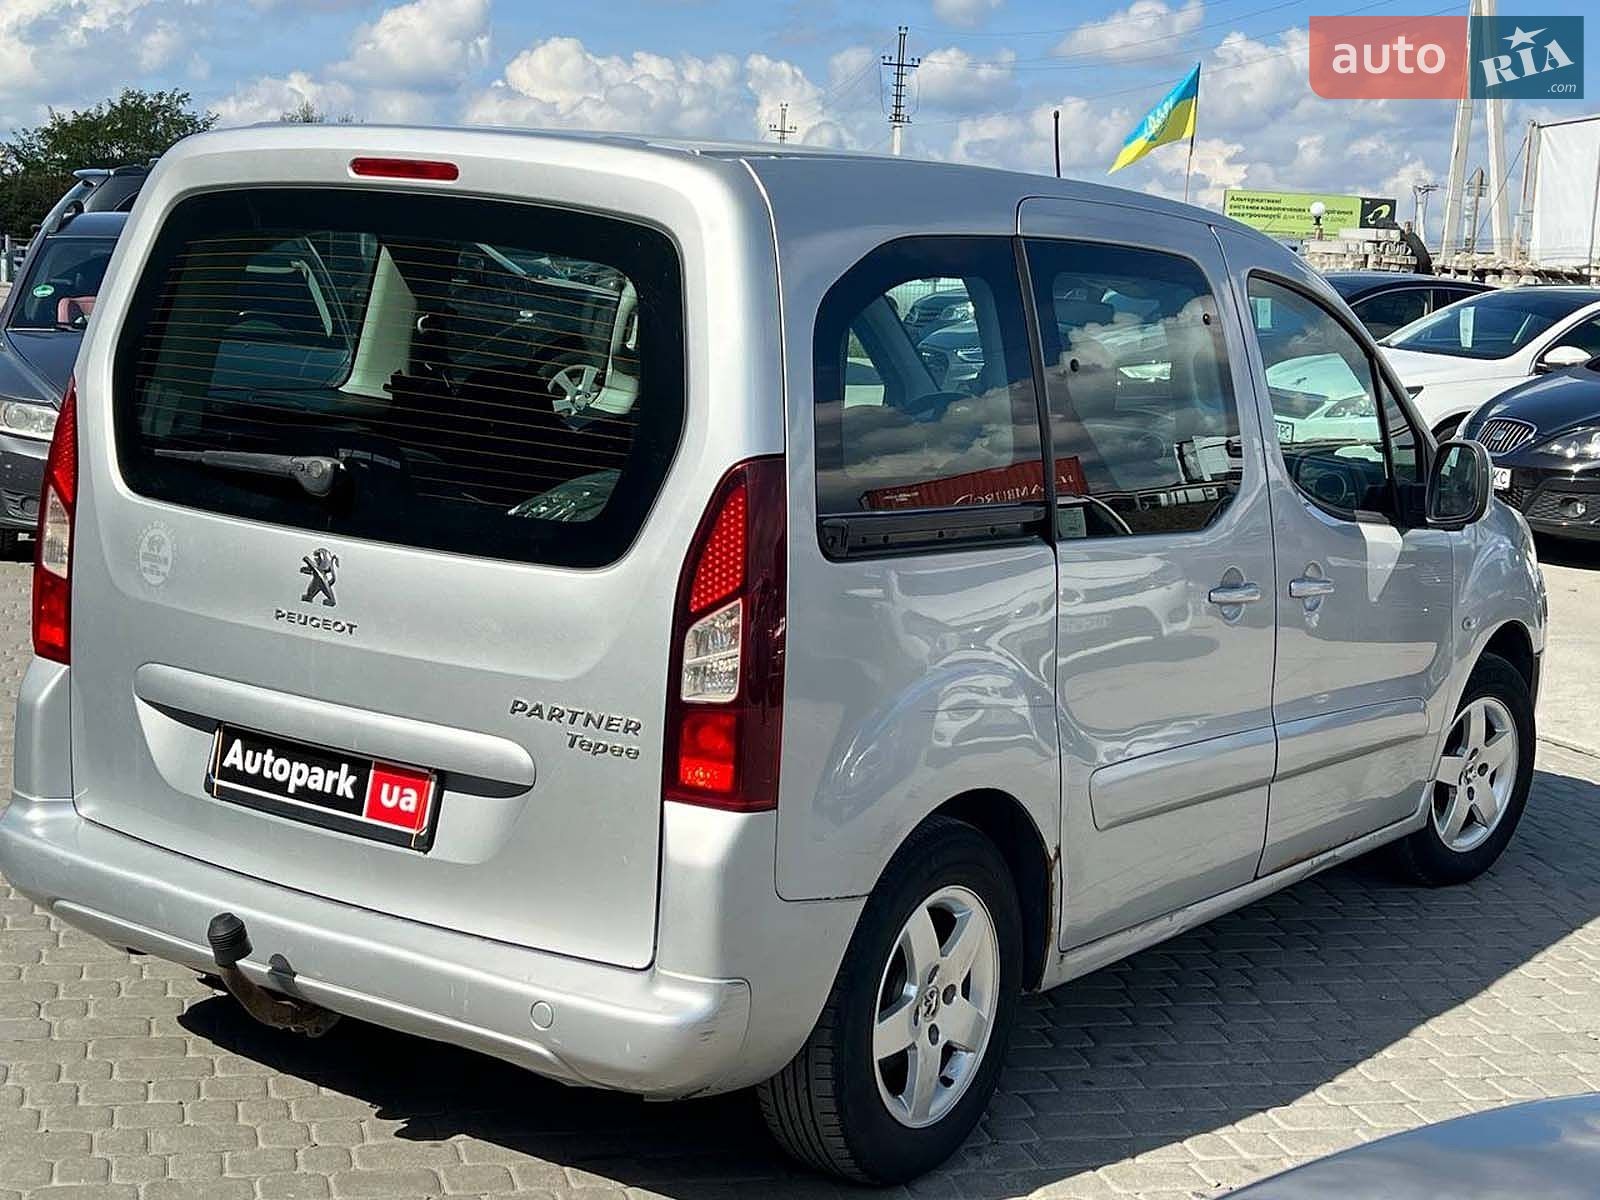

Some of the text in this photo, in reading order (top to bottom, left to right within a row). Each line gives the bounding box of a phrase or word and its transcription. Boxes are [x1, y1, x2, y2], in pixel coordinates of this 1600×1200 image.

[275, 608, 358, 636] PEUGEOT
[509, 699, 642, 737] PARTNER
[566, 731, 640, 760] Tepee
[222, 738, 419, 813] Autopark ua
